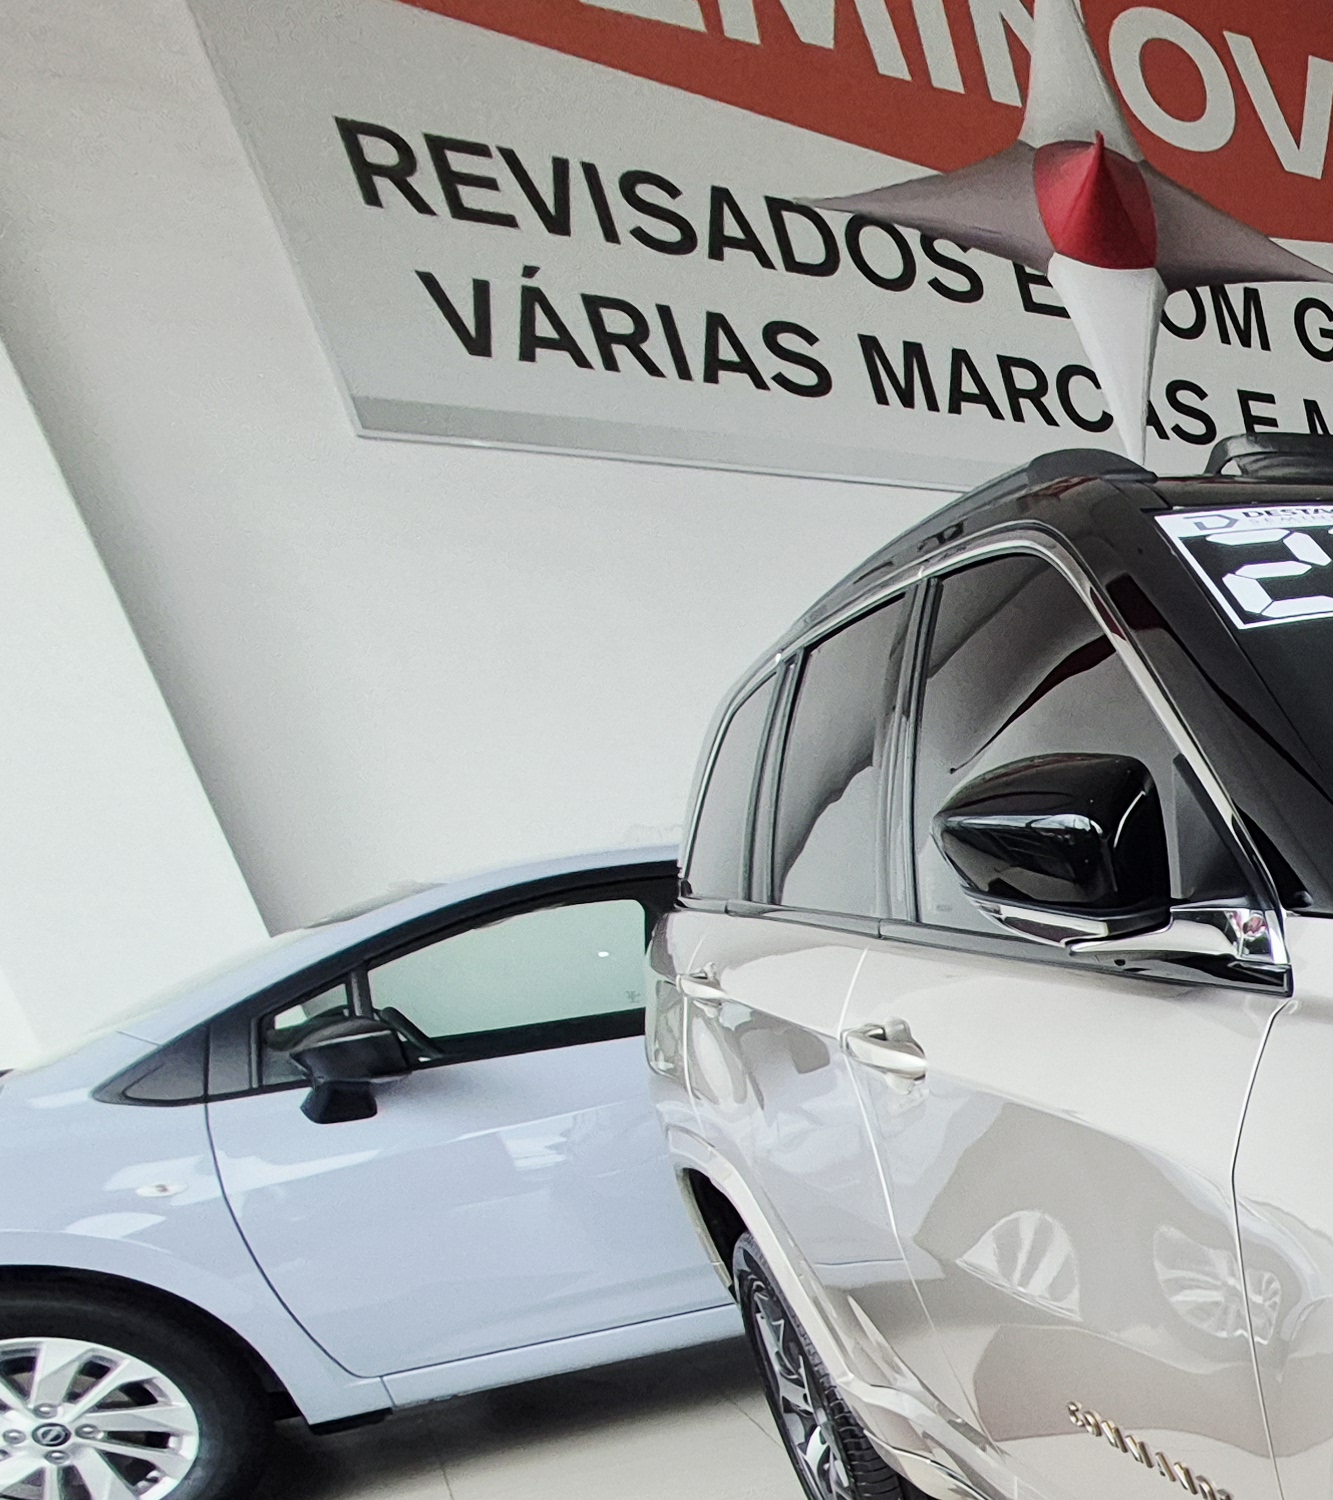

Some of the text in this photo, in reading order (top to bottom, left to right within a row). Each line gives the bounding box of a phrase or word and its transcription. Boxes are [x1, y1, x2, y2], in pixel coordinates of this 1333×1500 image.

[334, 115, 984, 304] REVISADOS
[1158, 282, 1271, 353] OM
[414, 265, 833, 398] VÁRIAS
[1237, 388, 1280, 434] E
